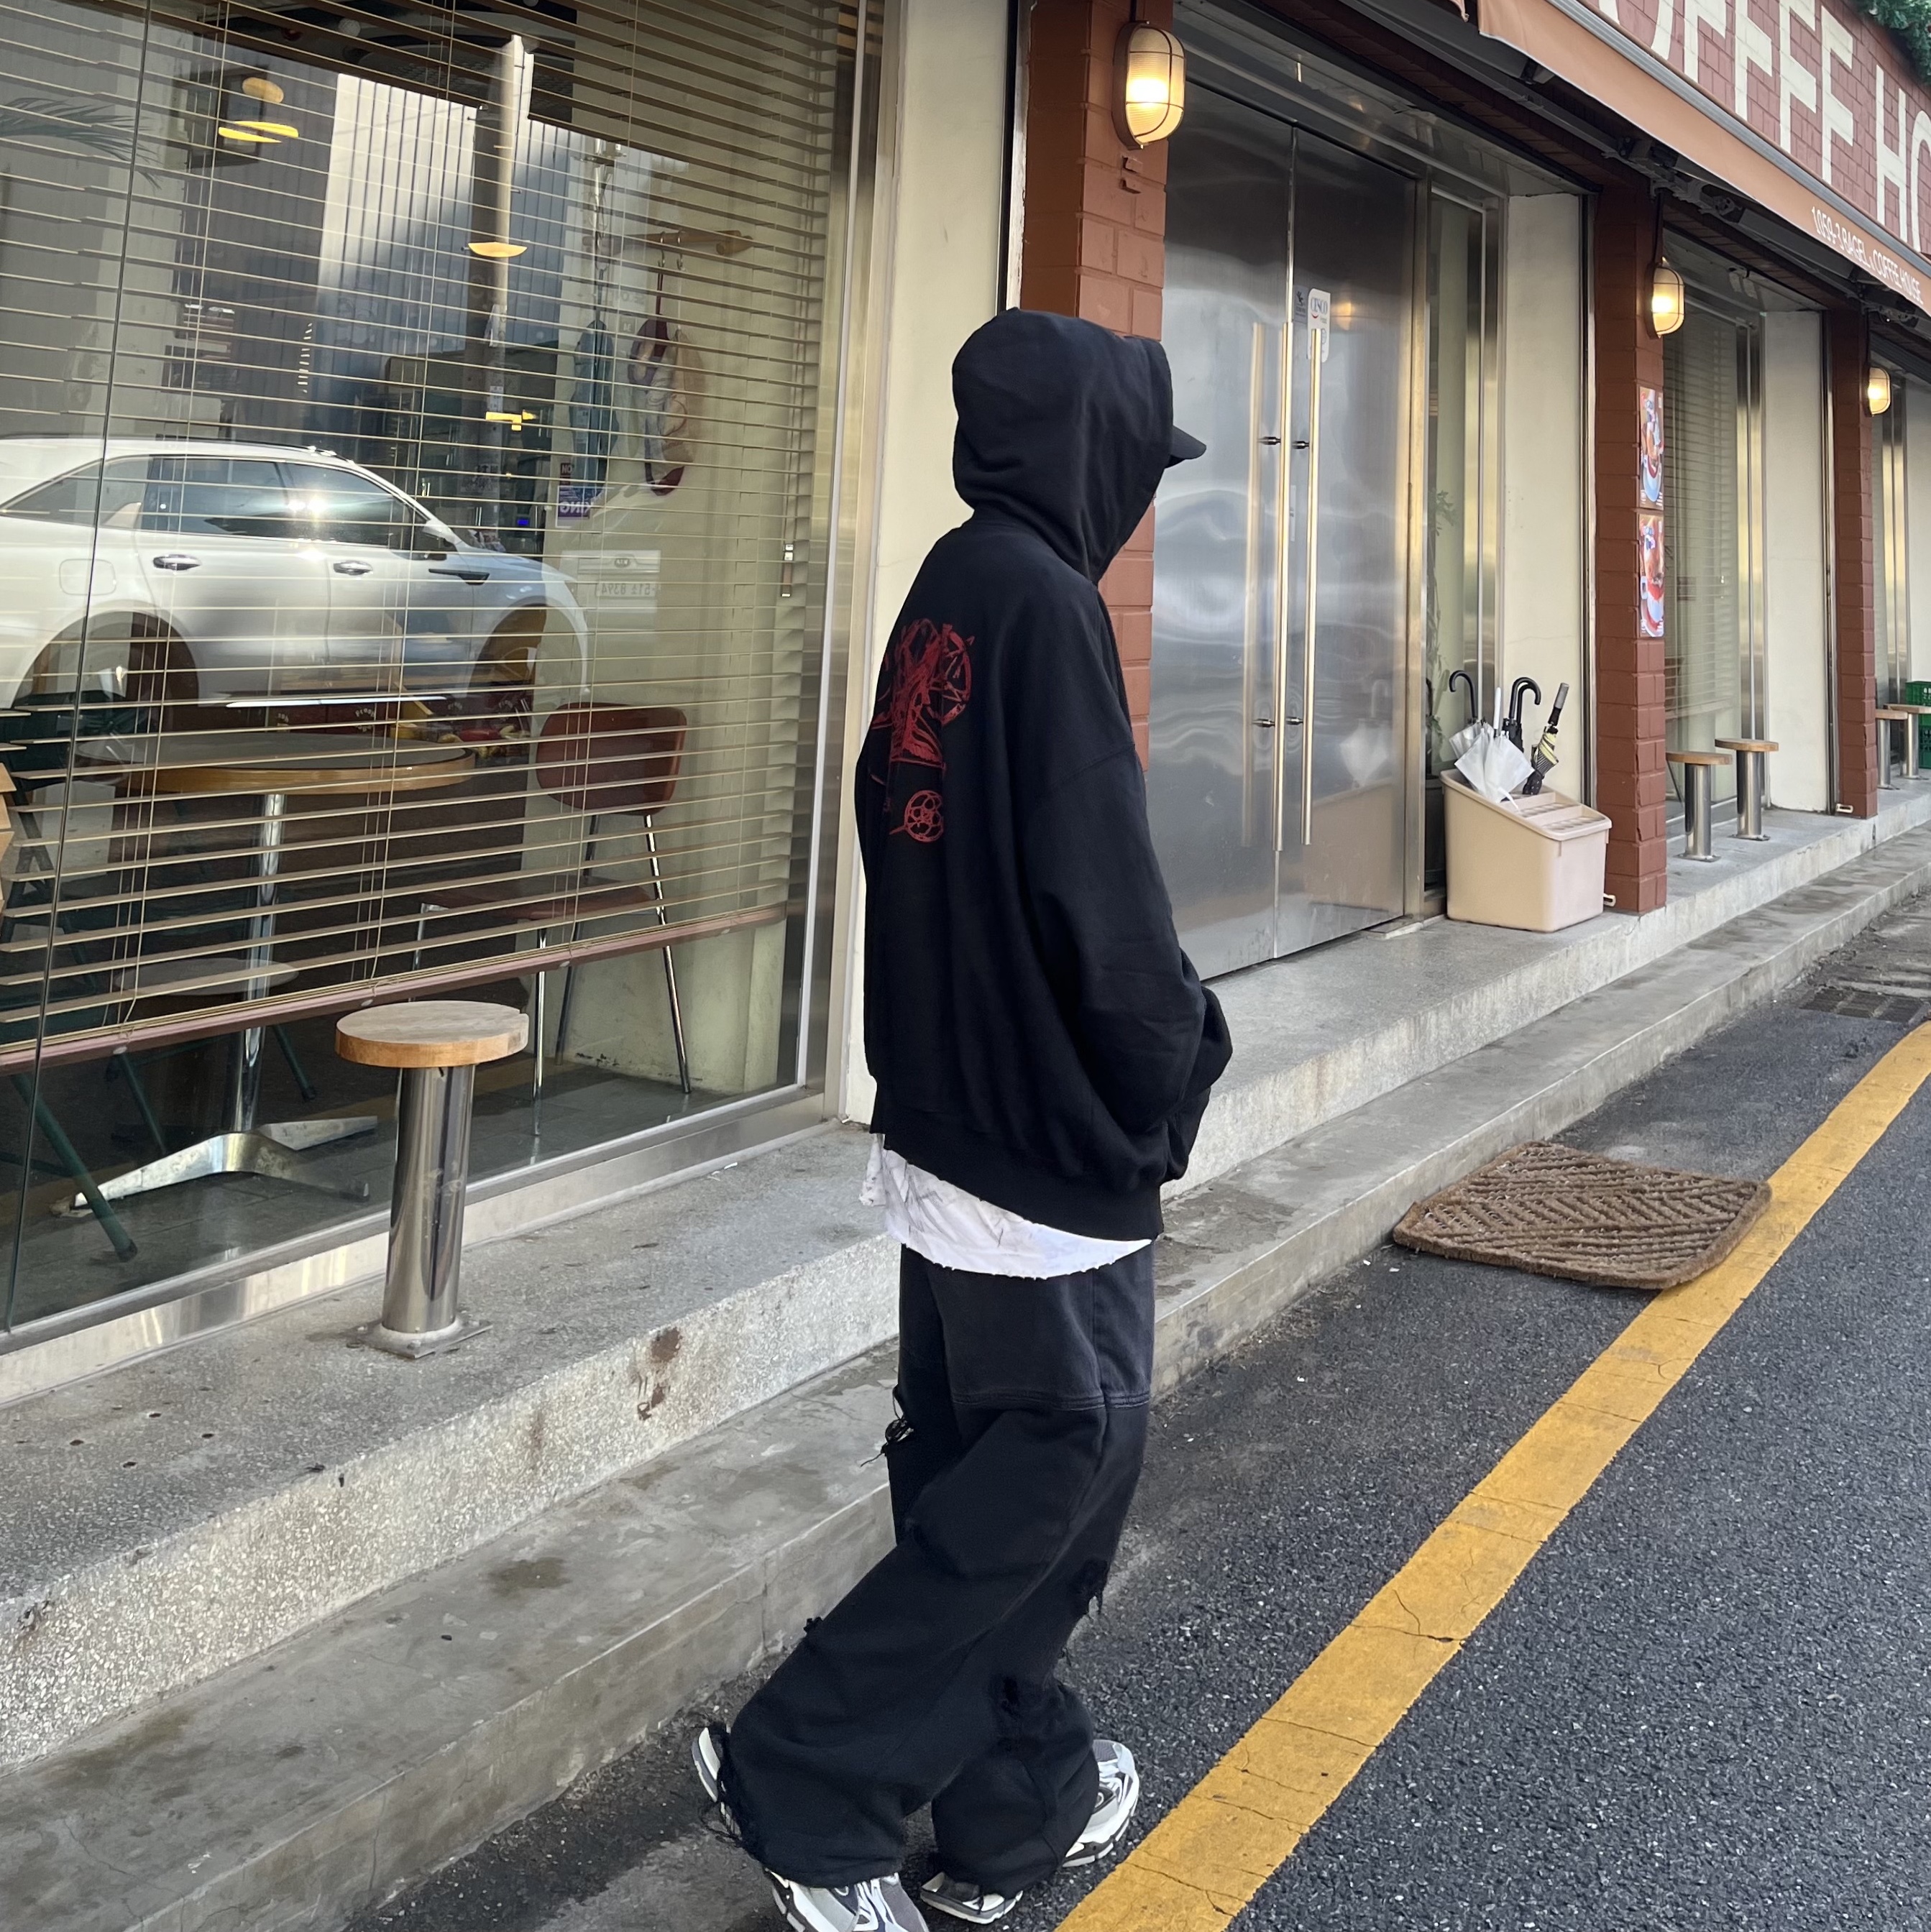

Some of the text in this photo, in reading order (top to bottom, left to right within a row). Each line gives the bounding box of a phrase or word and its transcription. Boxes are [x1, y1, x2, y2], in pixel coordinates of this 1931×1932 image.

[1811, 206, 1844, 251] 1059-3
[1872, 249, 1902, 289] COFFEE
[1900, 267, 1924, 305] HOUSE
